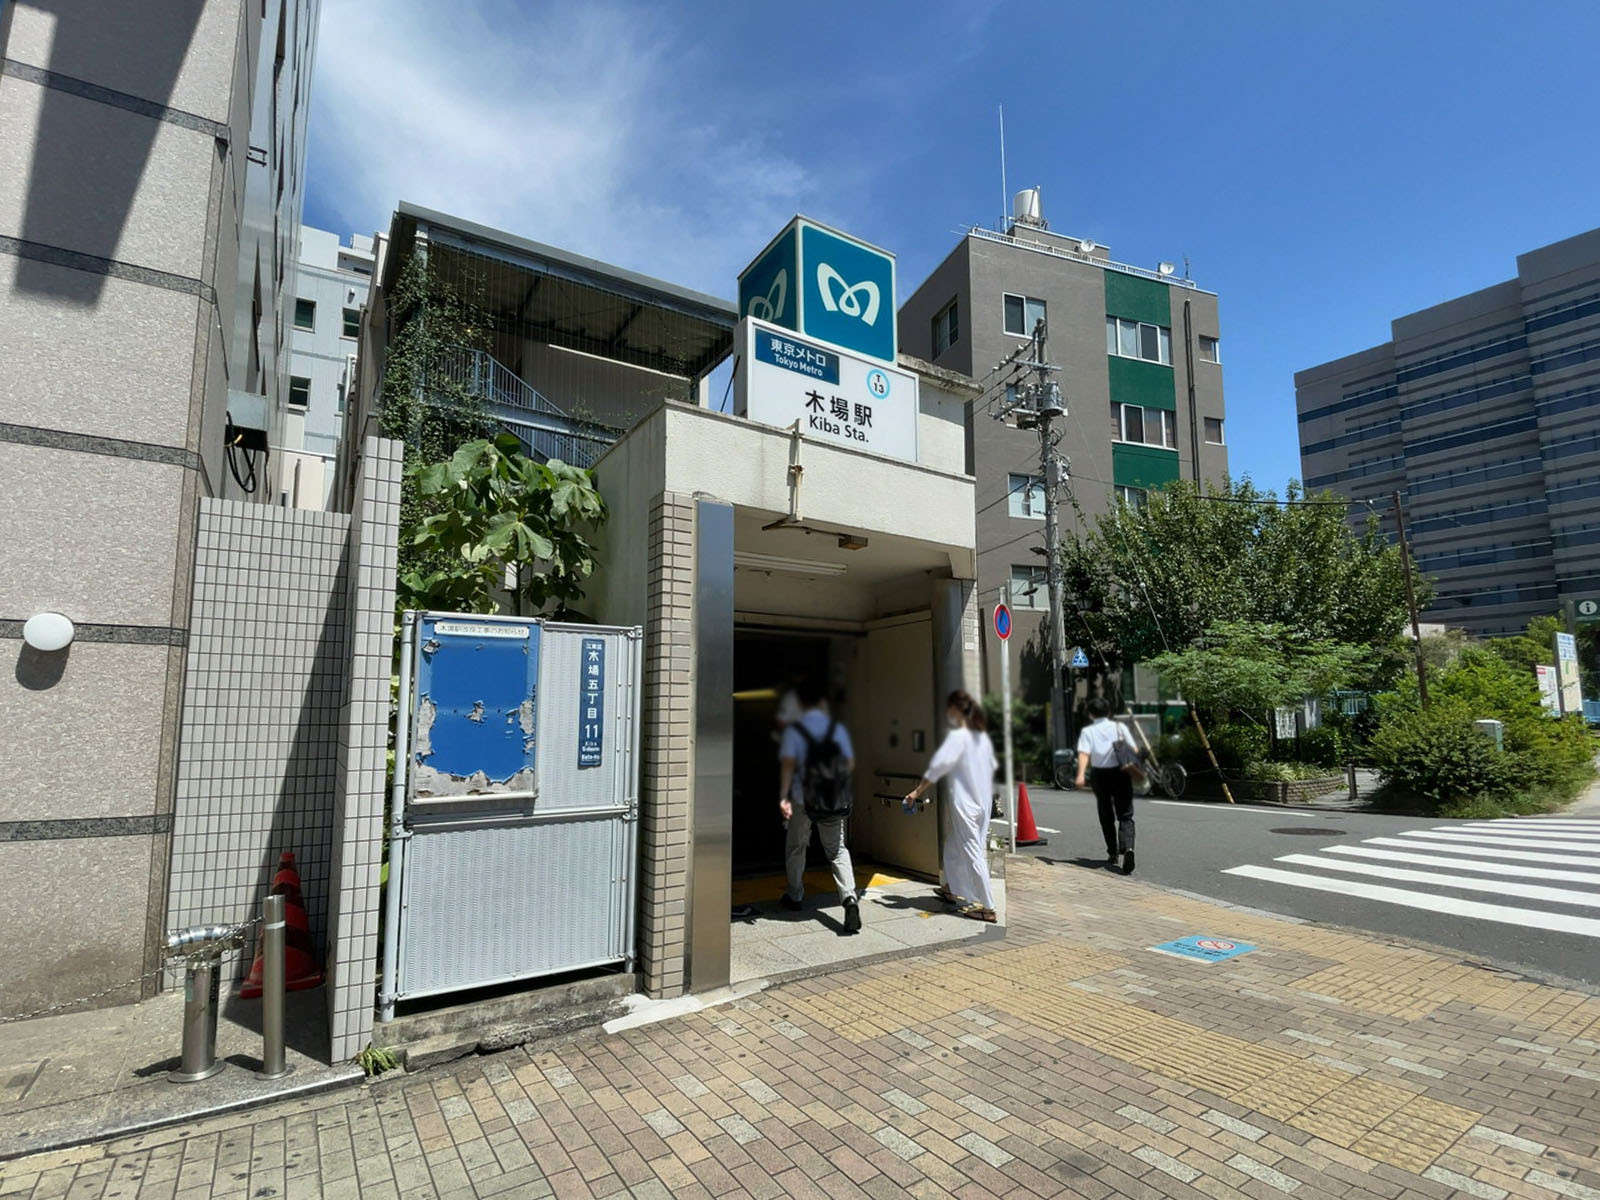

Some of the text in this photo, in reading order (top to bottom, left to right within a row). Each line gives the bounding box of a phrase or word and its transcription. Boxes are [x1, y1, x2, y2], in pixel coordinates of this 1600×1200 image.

[770, 338, 827, 368] 東京メトロ
[774, 353, 824, 377] Tokyo Metro
[873, 382, 885, 394] 13
[875, 374, 881, 383] T
[804, 389, 873, 429] 木場駅
[809, 414, 870, 443] Kiba Sta.
